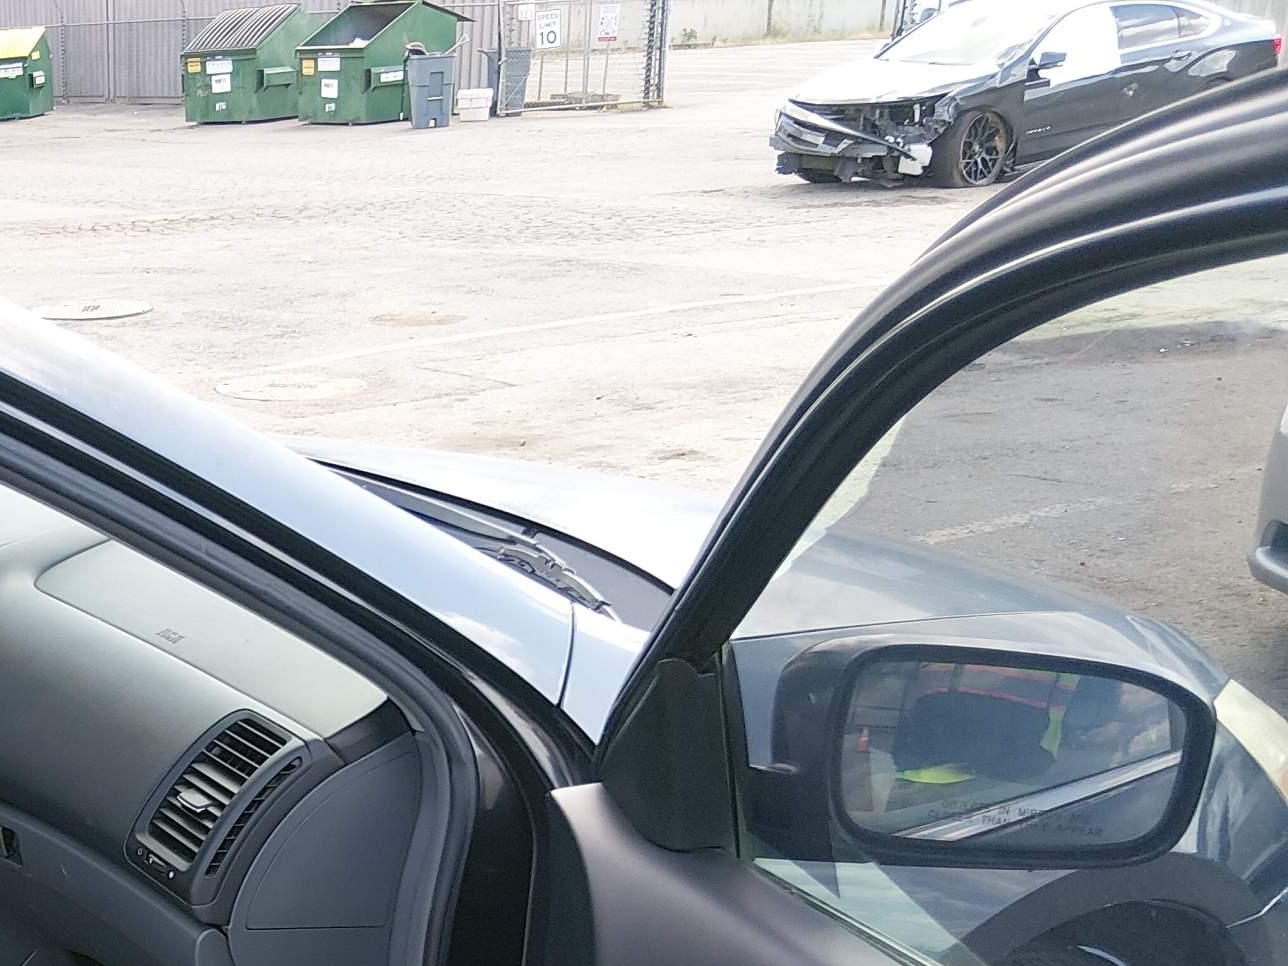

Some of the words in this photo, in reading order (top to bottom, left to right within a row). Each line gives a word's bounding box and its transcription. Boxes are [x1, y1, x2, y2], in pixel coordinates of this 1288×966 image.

[537, 12, 559, 20] SPEED
[539, 21, 557, 29] LIMIT
[539, 30, 557, 45] 10
